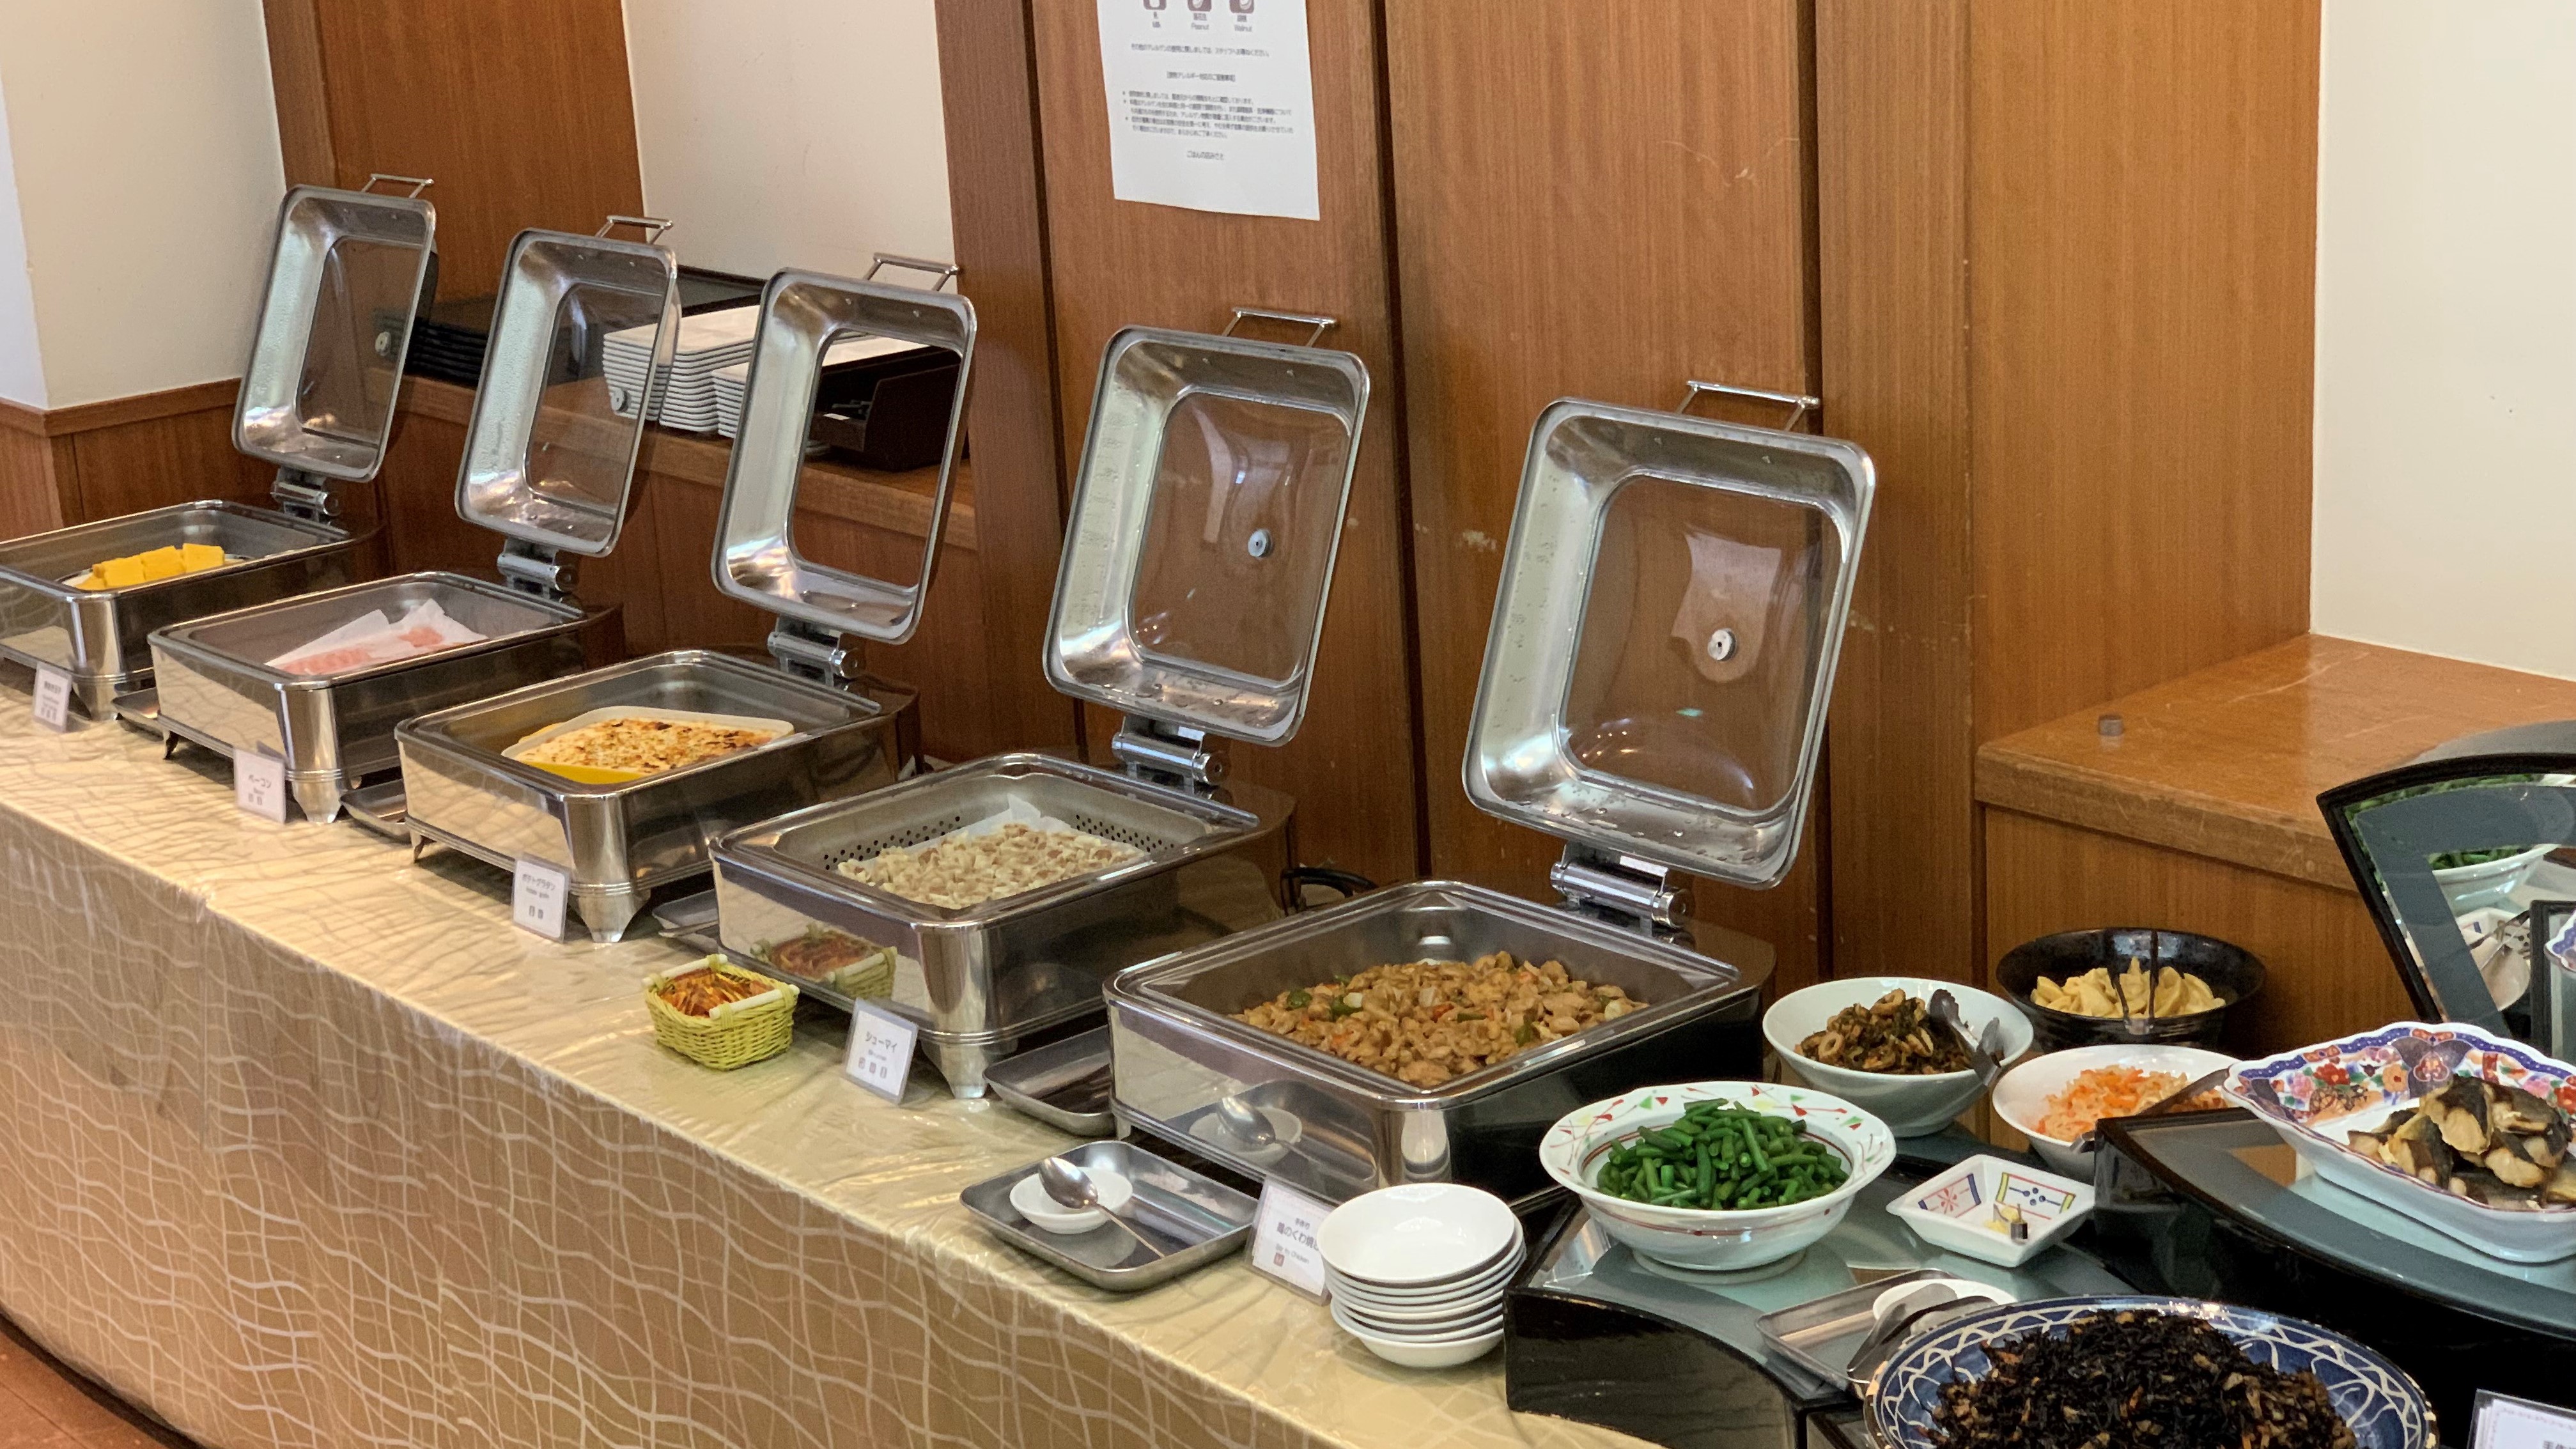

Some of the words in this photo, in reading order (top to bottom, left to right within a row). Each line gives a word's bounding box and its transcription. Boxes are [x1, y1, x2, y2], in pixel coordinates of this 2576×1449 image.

[865, 1031, 897, 1053] シューマイ
